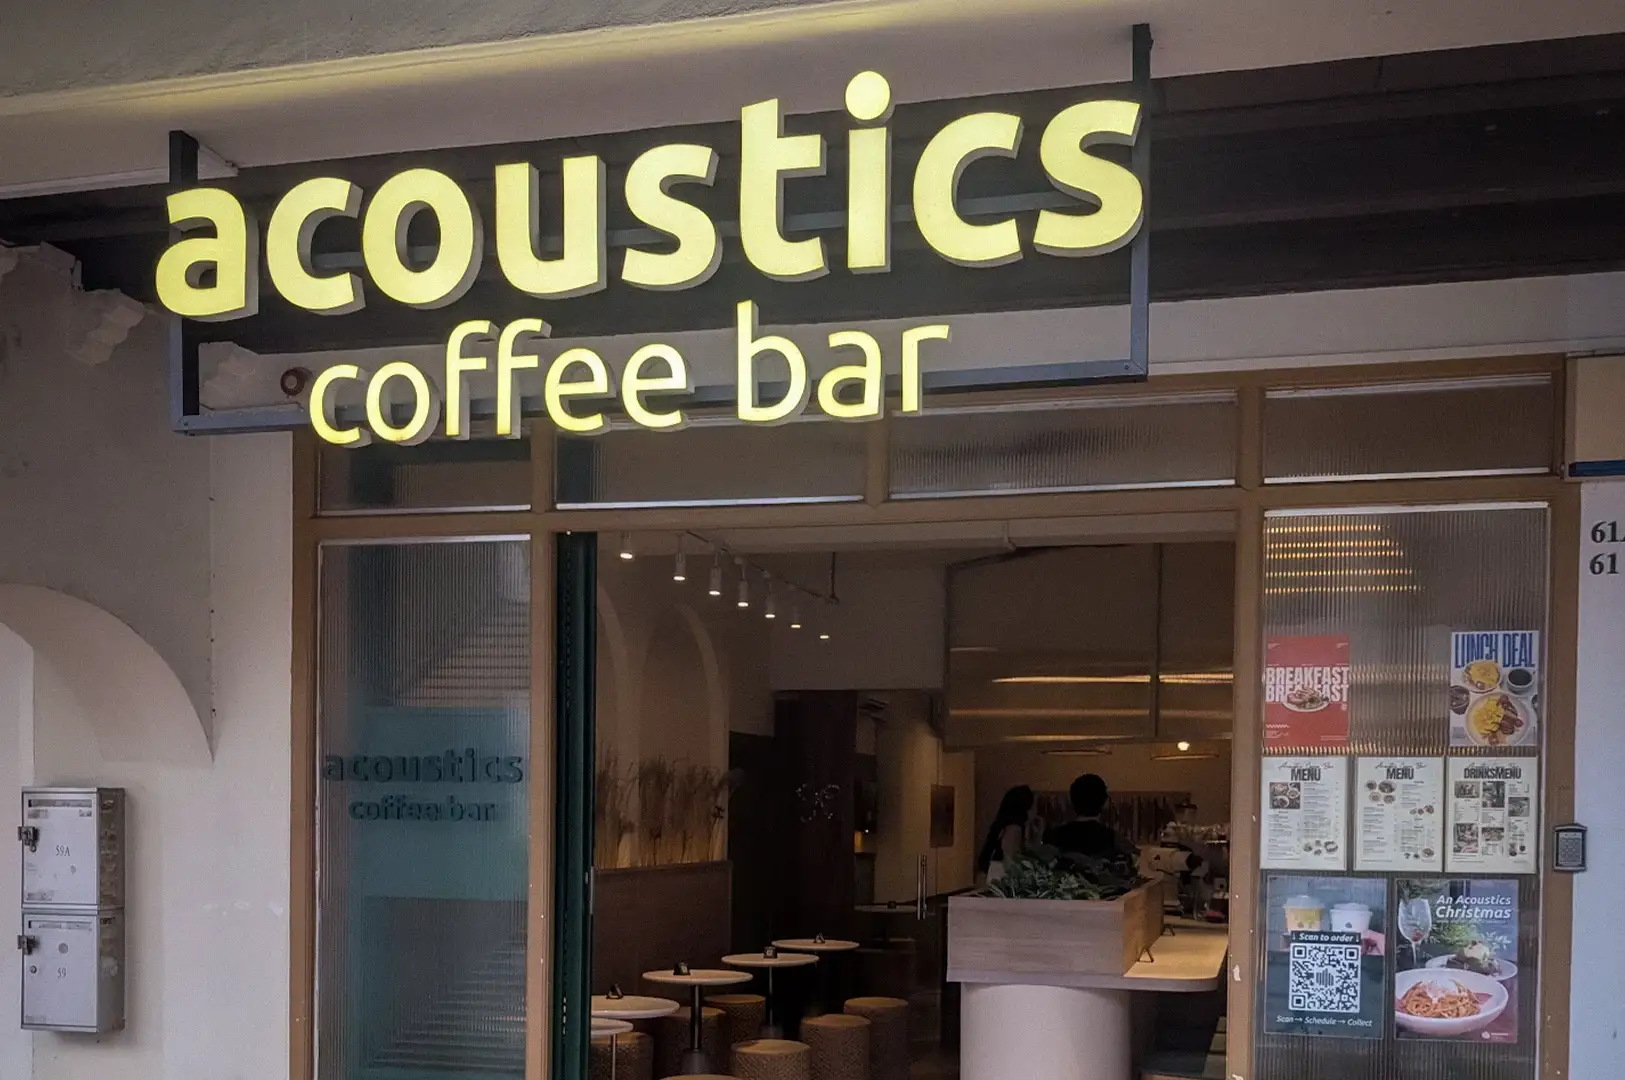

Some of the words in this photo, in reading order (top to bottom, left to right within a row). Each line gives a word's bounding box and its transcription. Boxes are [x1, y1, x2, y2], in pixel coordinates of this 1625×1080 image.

[154, 70, 1144, 321] acoustics
[309, 318, 692, 447] coffee
[737, 300, 951, 423] bar
[1591, 520, 1625, 543] 61
[1589, 553, 1619, 575] 61
[1455, 633, 1499, 668] LUNCH
[1502, 632, 1535, 667] DEAL
[1265, 666, 1349, 685] BREAKFAST
[324, 747, 524, 783] acoustics
[1290, 767, 1321, 781] MENU
[1386, 767, 1414, 780] MENU
[350, 794, 439, 821] coffee
[450, 795, 496, 821] bar
[56, 844, 71, 857] 59A
[1436, 894, 1453, 904] An
[1455, 894, 1512, 905] Acoustics
[1435, 905, 1512, 918] Christmas
[1299, 932, 1319, 941] Scan
[1320, 933, 1329, 941] to
[1331, 934, 1354, 942] order
[57, 967, 67, 979] 59
[1276, 1015, 1294, 1023] Scan
[1304, 1016, 1337, 1025] Schedule
[1347, 1018, 1373, 1027] Collect
